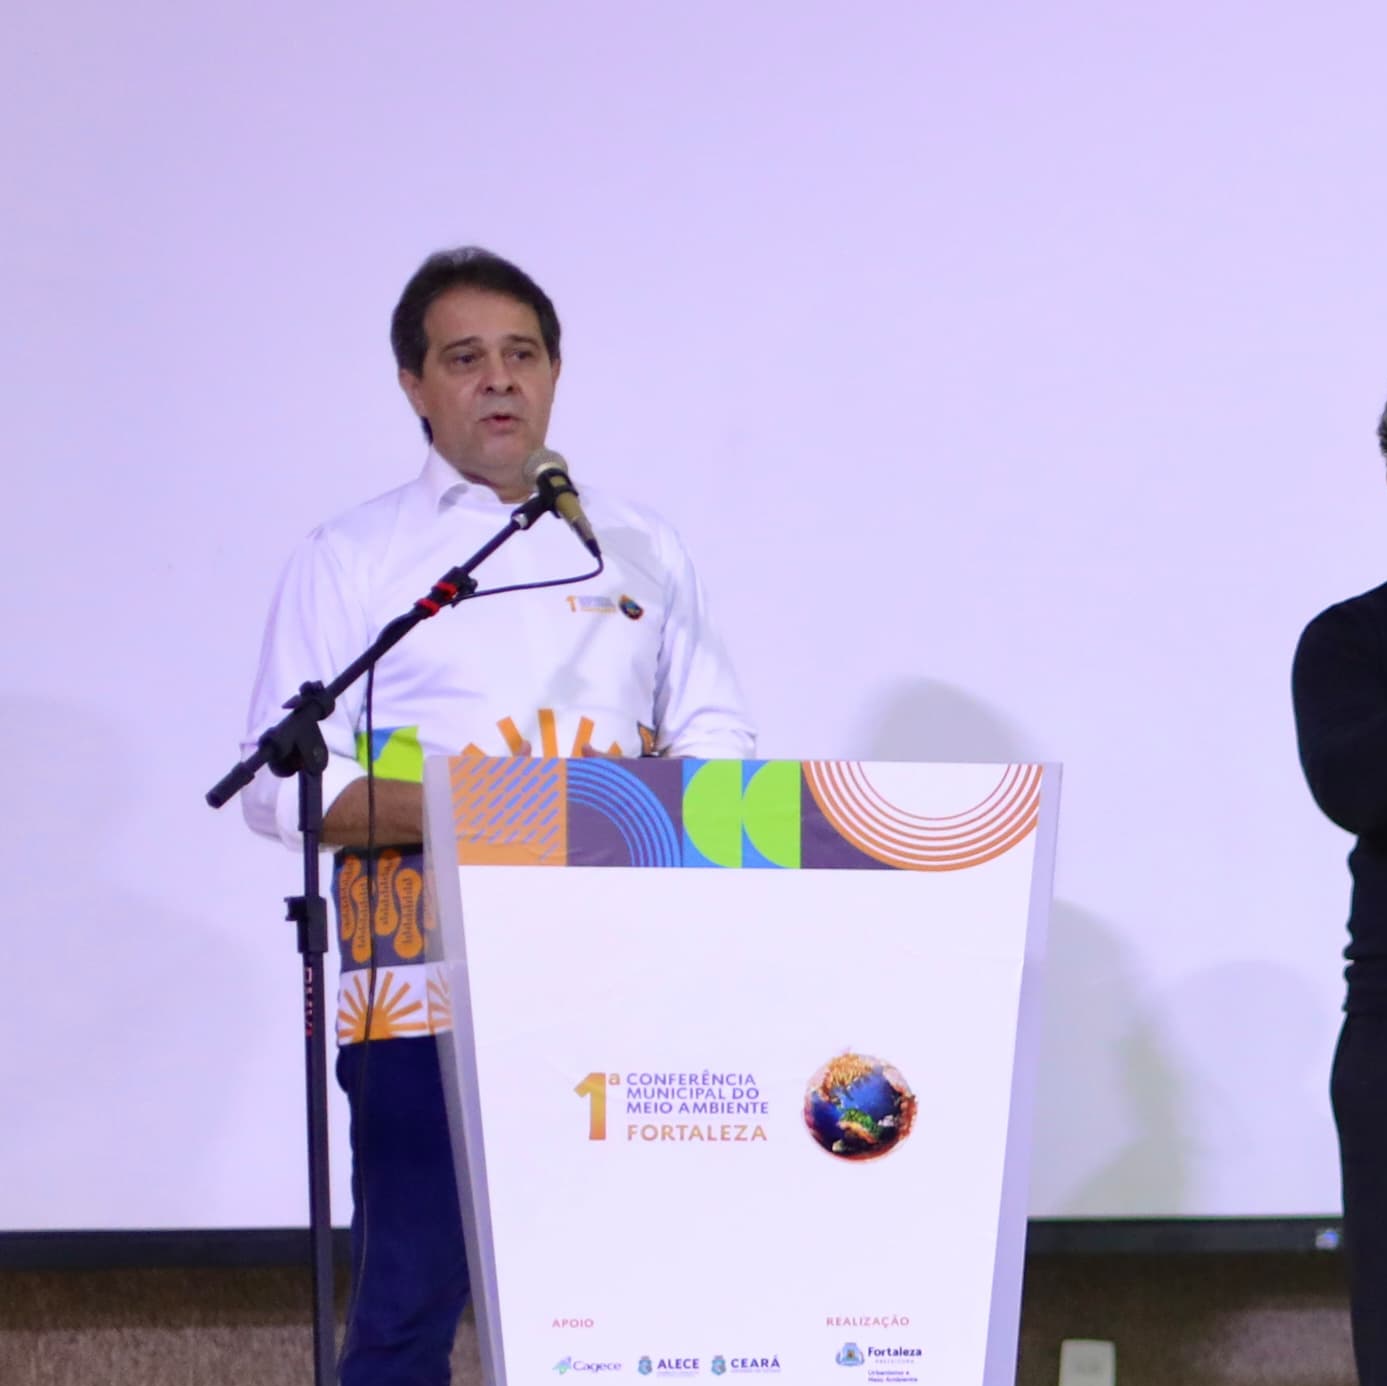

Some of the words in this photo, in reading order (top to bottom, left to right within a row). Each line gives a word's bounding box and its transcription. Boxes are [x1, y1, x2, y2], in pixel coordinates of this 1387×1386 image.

[626, 1069, 756, 1086] CONFERÊNCIA
[626, 1087, 726, 1100] MUNICIPAL
[731, 1087, 760, 1100] DO
[626, 1101, 673, 1114] MEIO
[678, 1101, 769, 1114] AMBIENTE
[627, 1124, 768, 1142] FORTALEZA
[552, 1318, 594, 1328] APOIO
[826, 1315, 910, 1328] REALIZAÇÃO
[868, 1346, 922, 1357] Fortaleza
[573, 1361, 621, 1372] Cagece
[657, 1358, 699, 1369] ALECE
[730, 1354, 780, 1368] CEARÁ
